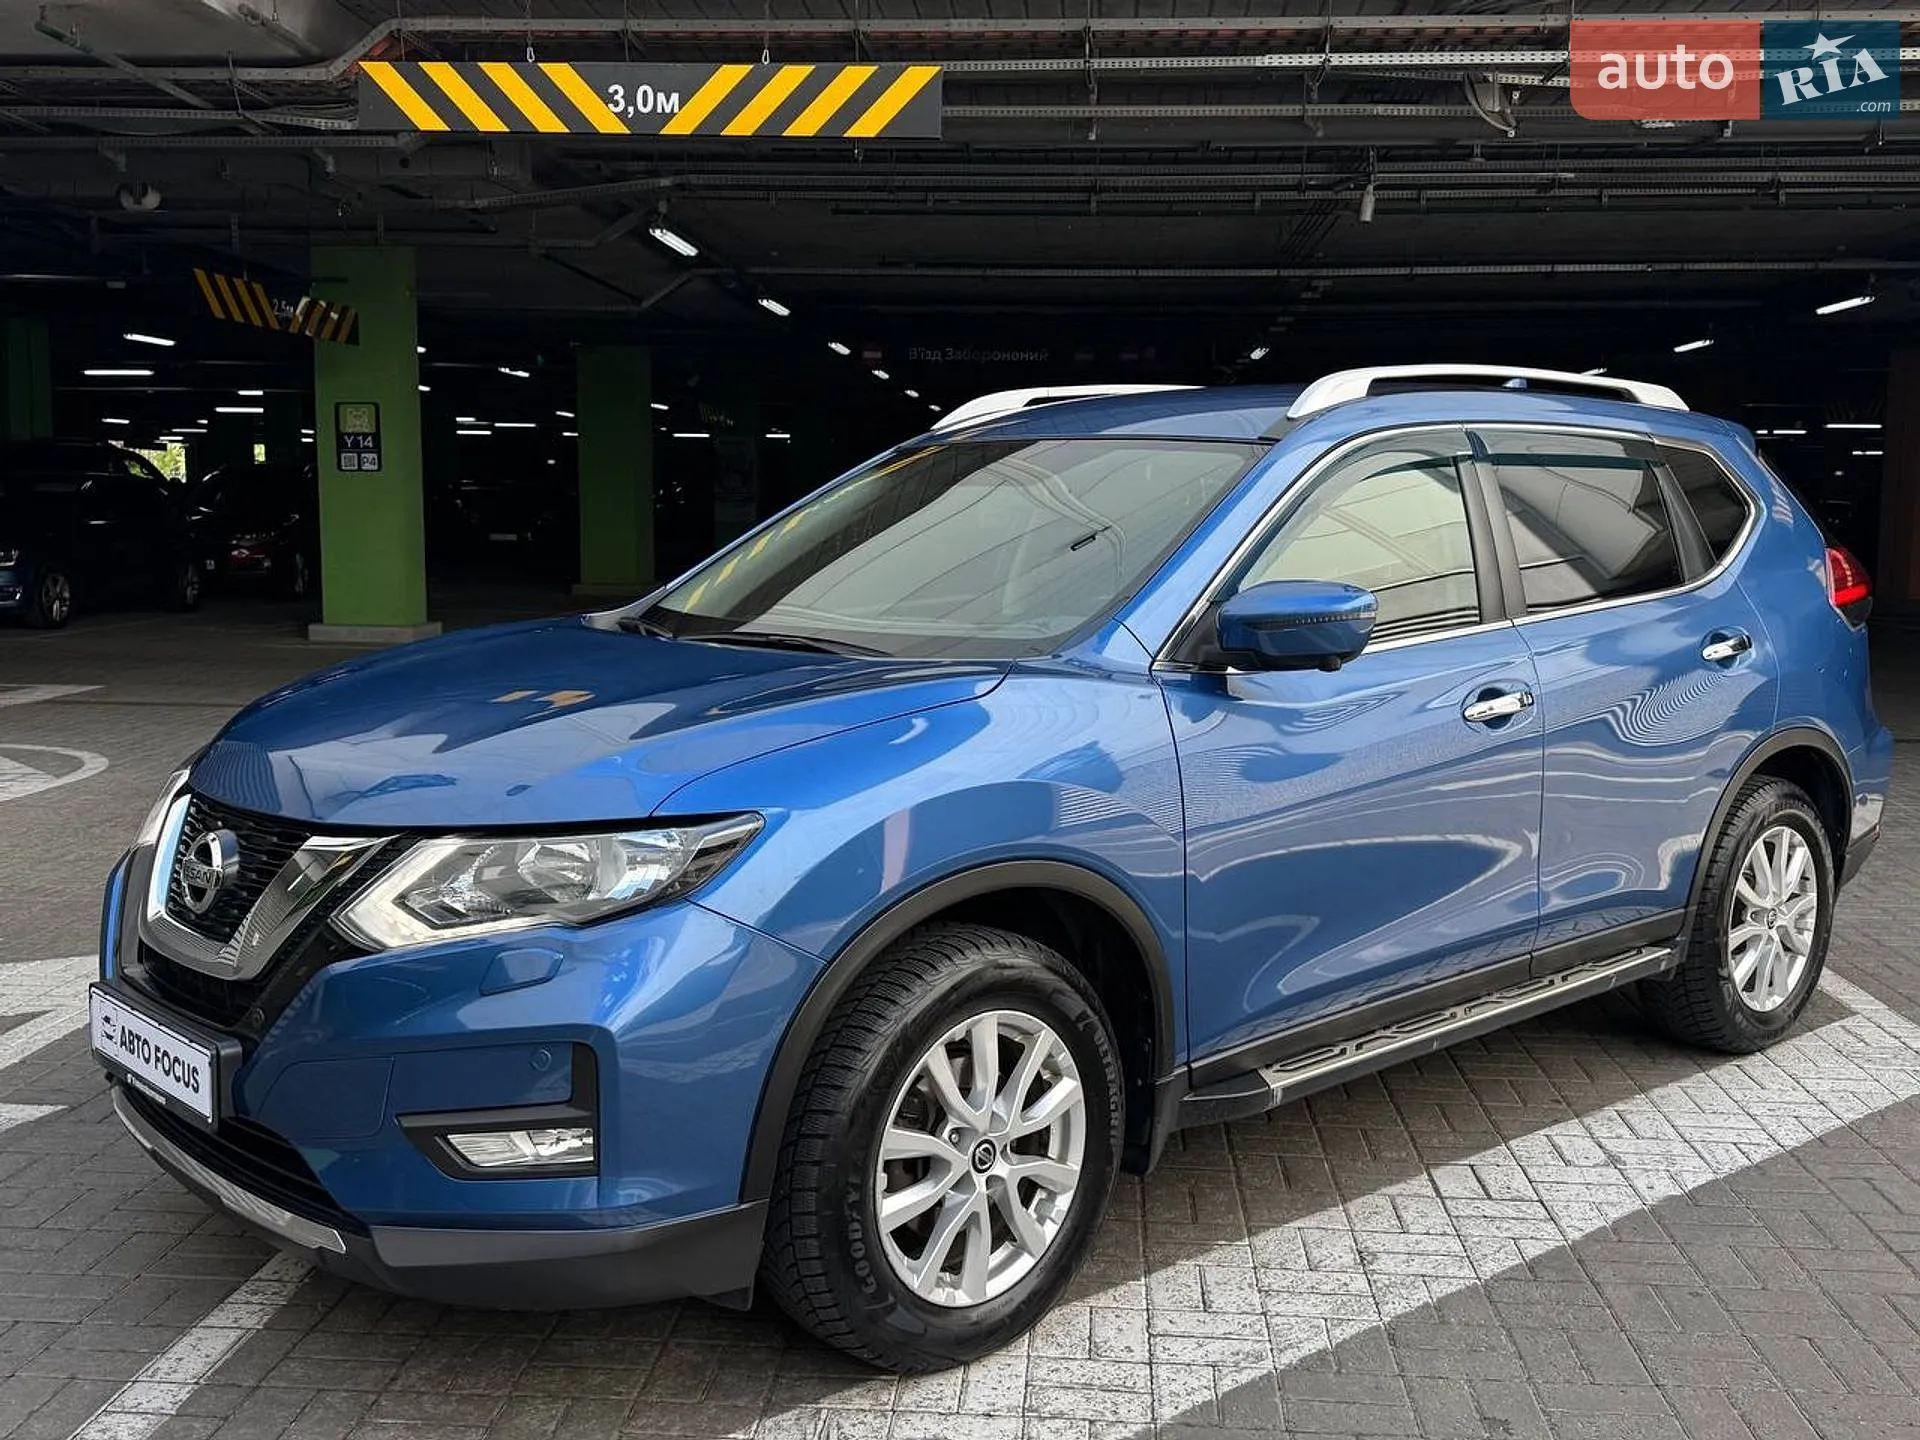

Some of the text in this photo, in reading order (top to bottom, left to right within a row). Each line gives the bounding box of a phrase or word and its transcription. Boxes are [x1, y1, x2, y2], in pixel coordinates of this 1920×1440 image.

[607, 84, 680, 118] 3,0м
[343, 435, 374, 449] Y 14
[120, 1025, 151, 1065] АВТО
[154, 1044, 199, 1094] FOCUS
